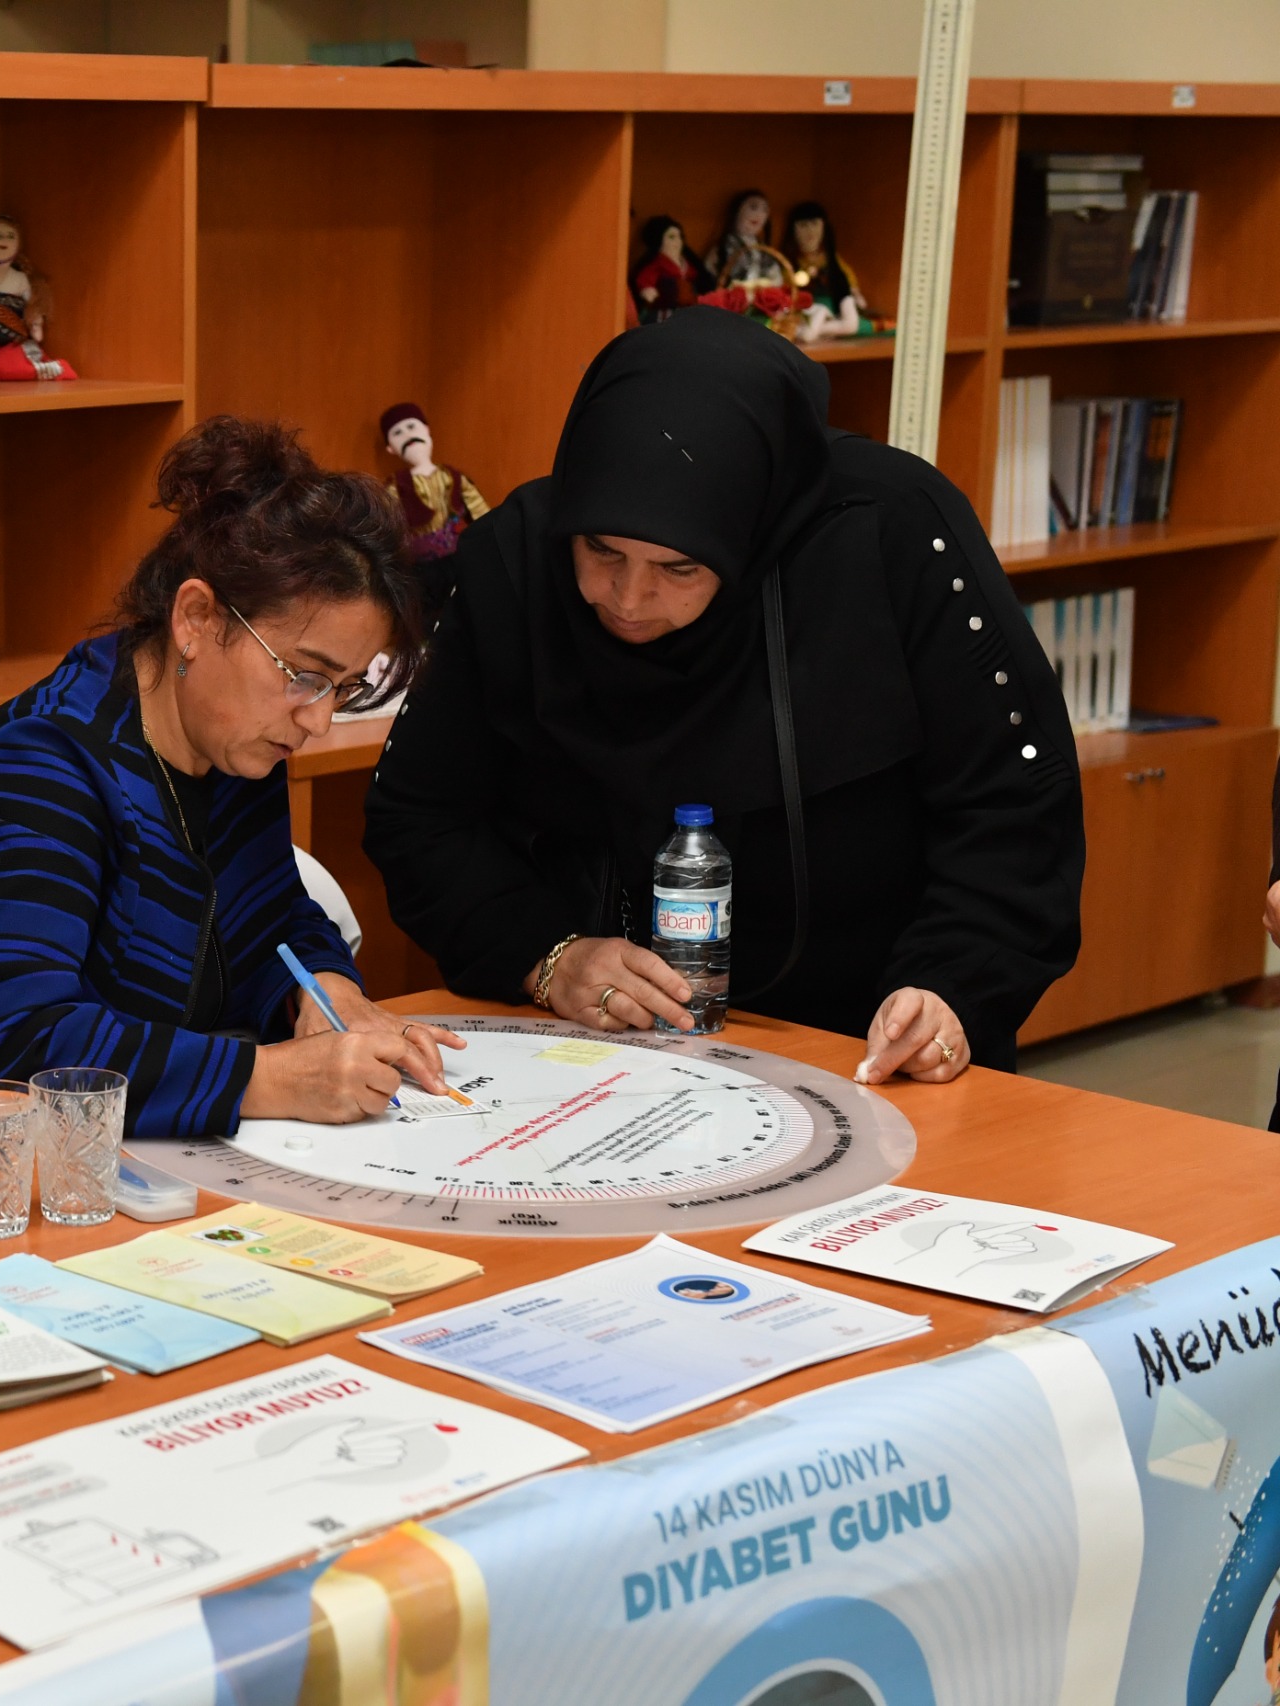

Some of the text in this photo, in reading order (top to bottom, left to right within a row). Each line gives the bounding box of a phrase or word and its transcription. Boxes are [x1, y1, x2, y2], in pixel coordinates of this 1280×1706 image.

[658, 911, 707, 930] abant
[777, 1230, 808, 1244] KAN
[810, 1218, 880, 1252] BİLİYOR
[1133, 1286, 1280, 1398] Menü
[143, 1410, 266, 1453] BİLİYOR
[654, 1439, 906, 1544] 14 KASIM DÜNYA
